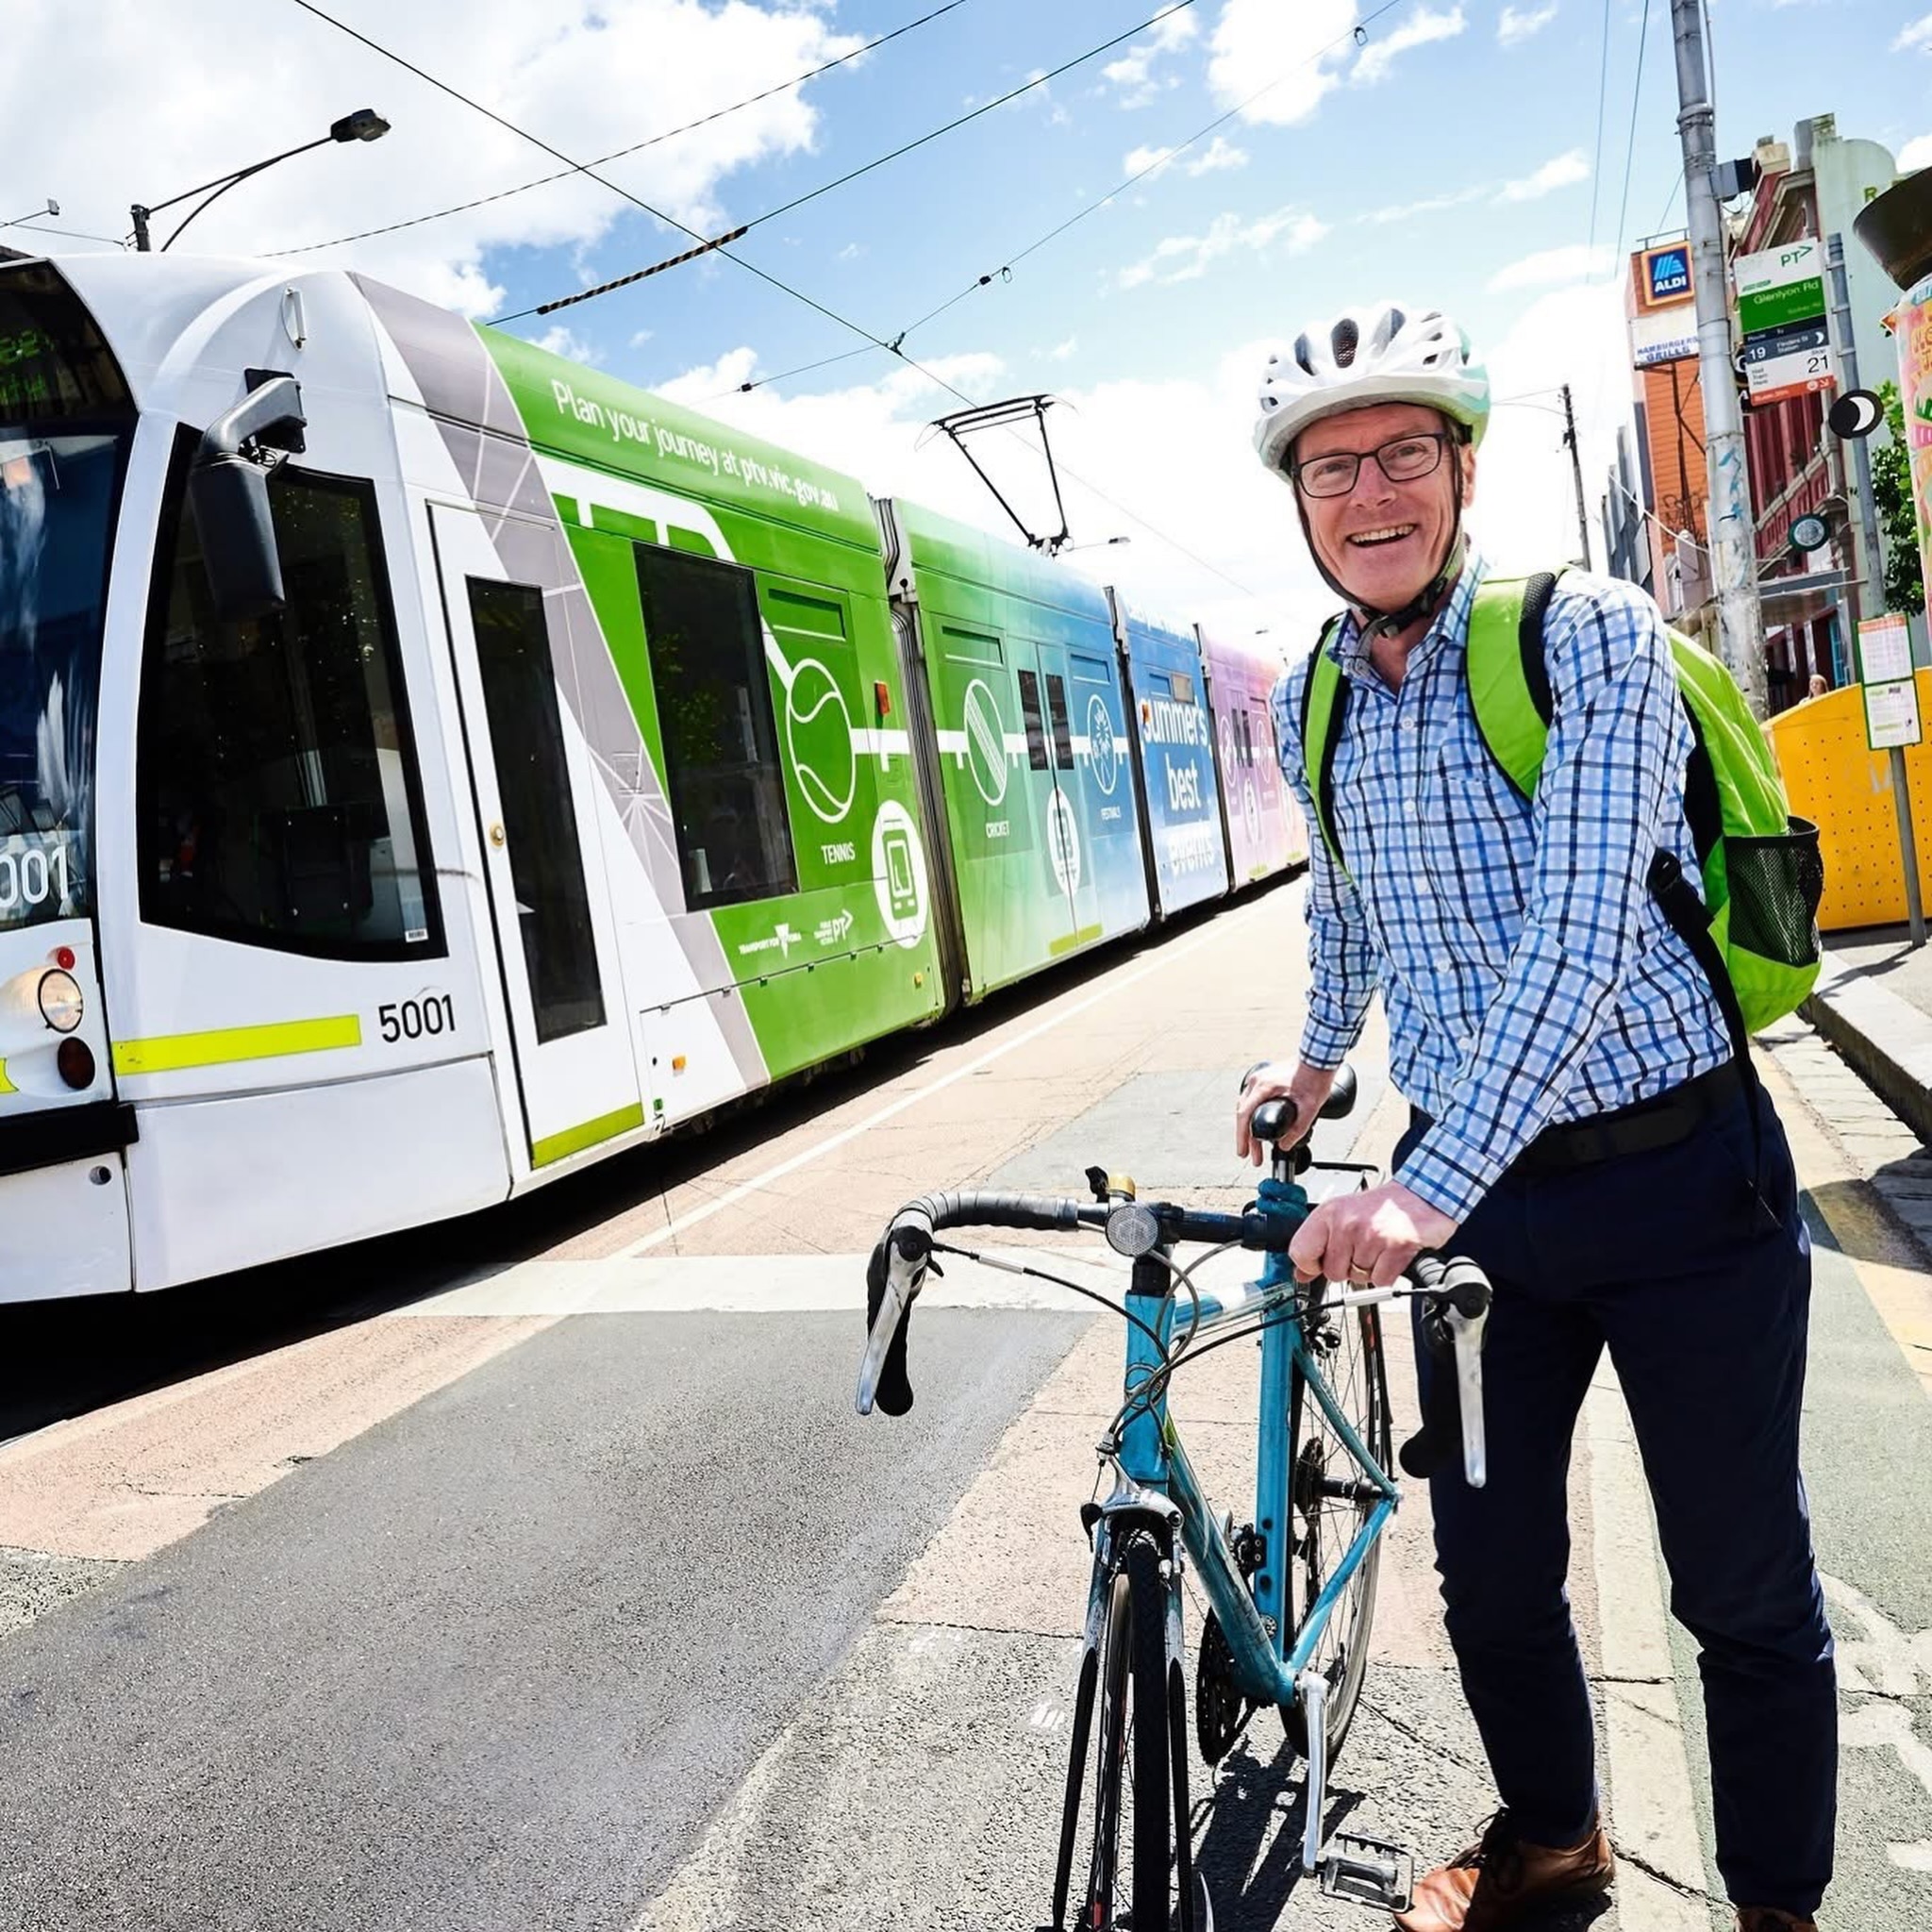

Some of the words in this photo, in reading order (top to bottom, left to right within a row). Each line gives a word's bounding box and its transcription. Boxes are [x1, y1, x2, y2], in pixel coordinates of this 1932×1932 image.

[1655, 275, 1687, 292] ALDI
[1754, 286, 1801, 306] Glenlyon
[1803, 281, 1820, 291] Rd
[1637, 336, 1699, 356] HAMBURGERS
[1646, 346, 1690, 362] GRILLS
[1750, 346, 1766, 360] 19
[1807, 355, 1828, 374] 21
[551, 378, 606, 428] Plan
[606, 407, 651, 444] your
[651, 418, 719, 476] journey
[722, 449, 741, 476] at
[1165, 752, 1202, 811] best
[986, 820, 1010, 838] CRICKET
[821, 841, 856, 864] TENNIS
[378, 993, 456, 1043] 5001
